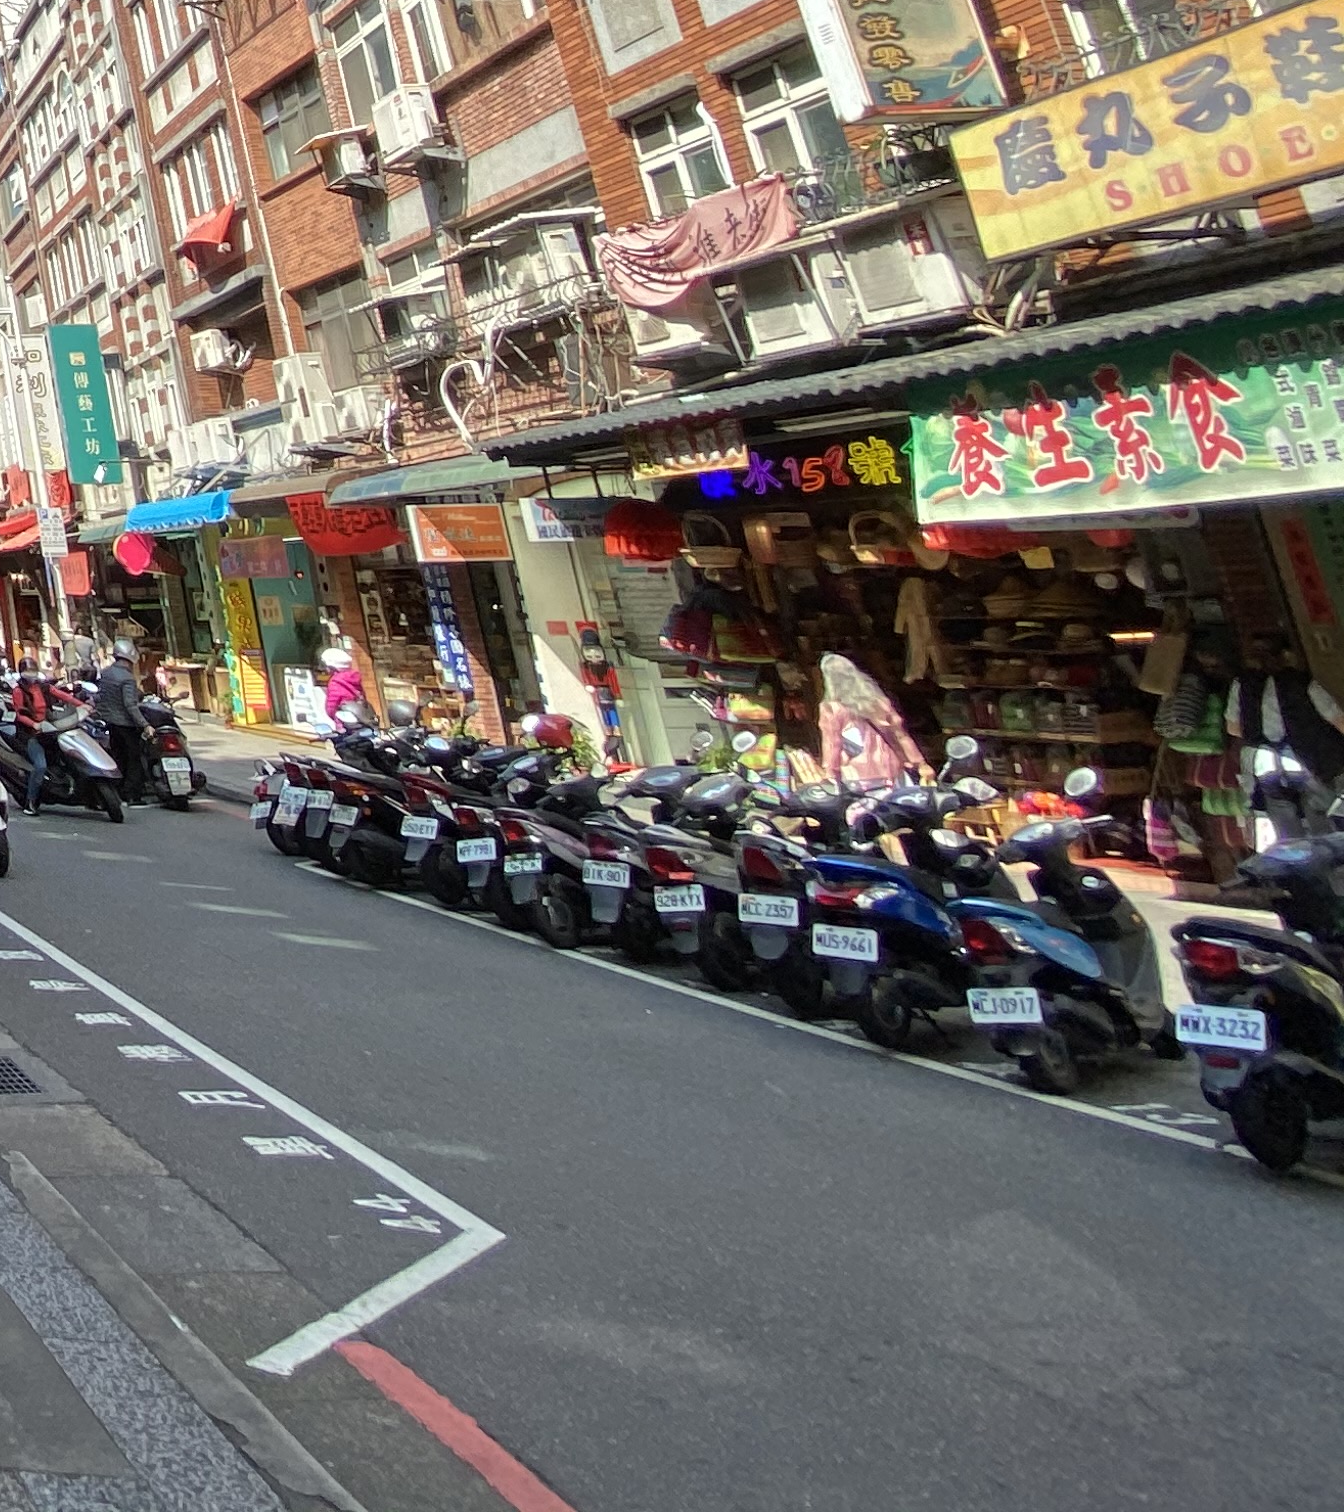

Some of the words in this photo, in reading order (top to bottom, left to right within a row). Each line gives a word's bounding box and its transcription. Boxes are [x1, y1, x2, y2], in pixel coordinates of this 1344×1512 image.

[698, 436, 902, 501] 水158號
[947, 349, 1247, 499] 養生素食
